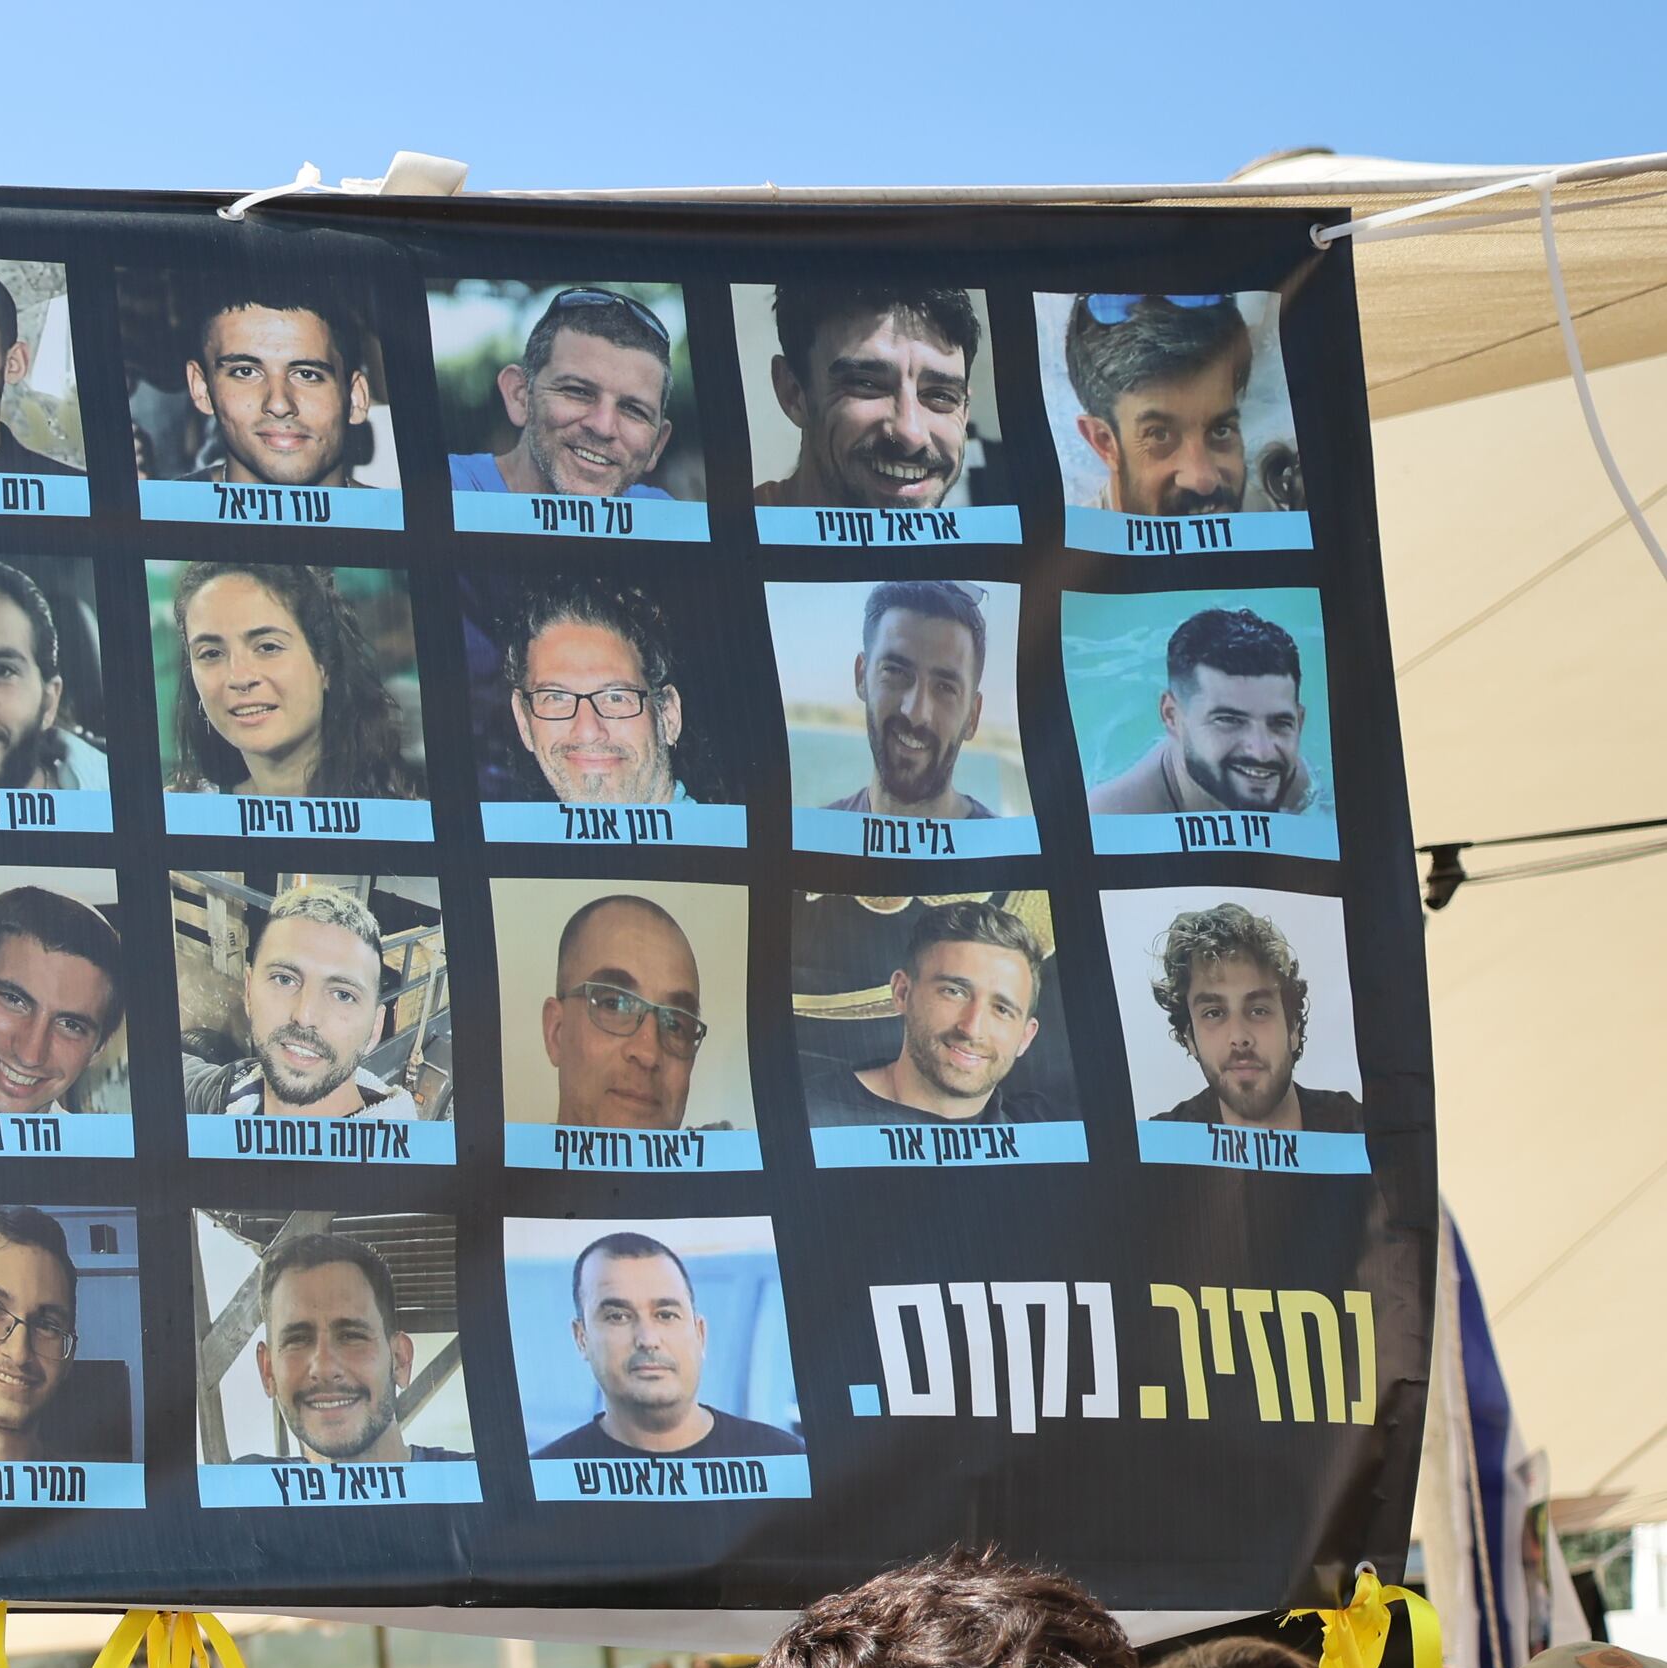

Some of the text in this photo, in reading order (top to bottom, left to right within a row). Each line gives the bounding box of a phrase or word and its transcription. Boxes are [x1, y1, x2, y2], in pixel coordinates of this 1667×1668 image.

[2, 477, 45, 511] רום
[213, 483, 331, 523] עוז דניאל
[531, 496, 633, 534] טל חיימי
[815, 509, 961, 546] אריאל קוניו
[1126, 517, 1233, 553] דוד קוניו
[6, 792, 56, 830] מתן
[237, 798, 361, 836] ענבר הימן
[559, 804, 673, 844] רונן אנגל
[862, 817, 956, 855] גלי ברמן
[1174, 814, 1272, 852] זיו ברמן
[10, 1117, 61, 1152] הדר
[234, 1119, 411, 1162] אלקנה בוחבוט
[554, 1129, 704, 1169] ליאור רודאיף
[879, 1126, 1020, 1165] אבינתן אור
[1207, 1124, 1300, 1169] אלון אהל
[849, 1282, 1377, 1434] נחזיר. נקום.
[22, 1465, 86, 1502] תמיר
[271, 1465, 407, 1506] דניאל פרץ
[574, 1457, 768, 1496] מחמד אלאטרש
